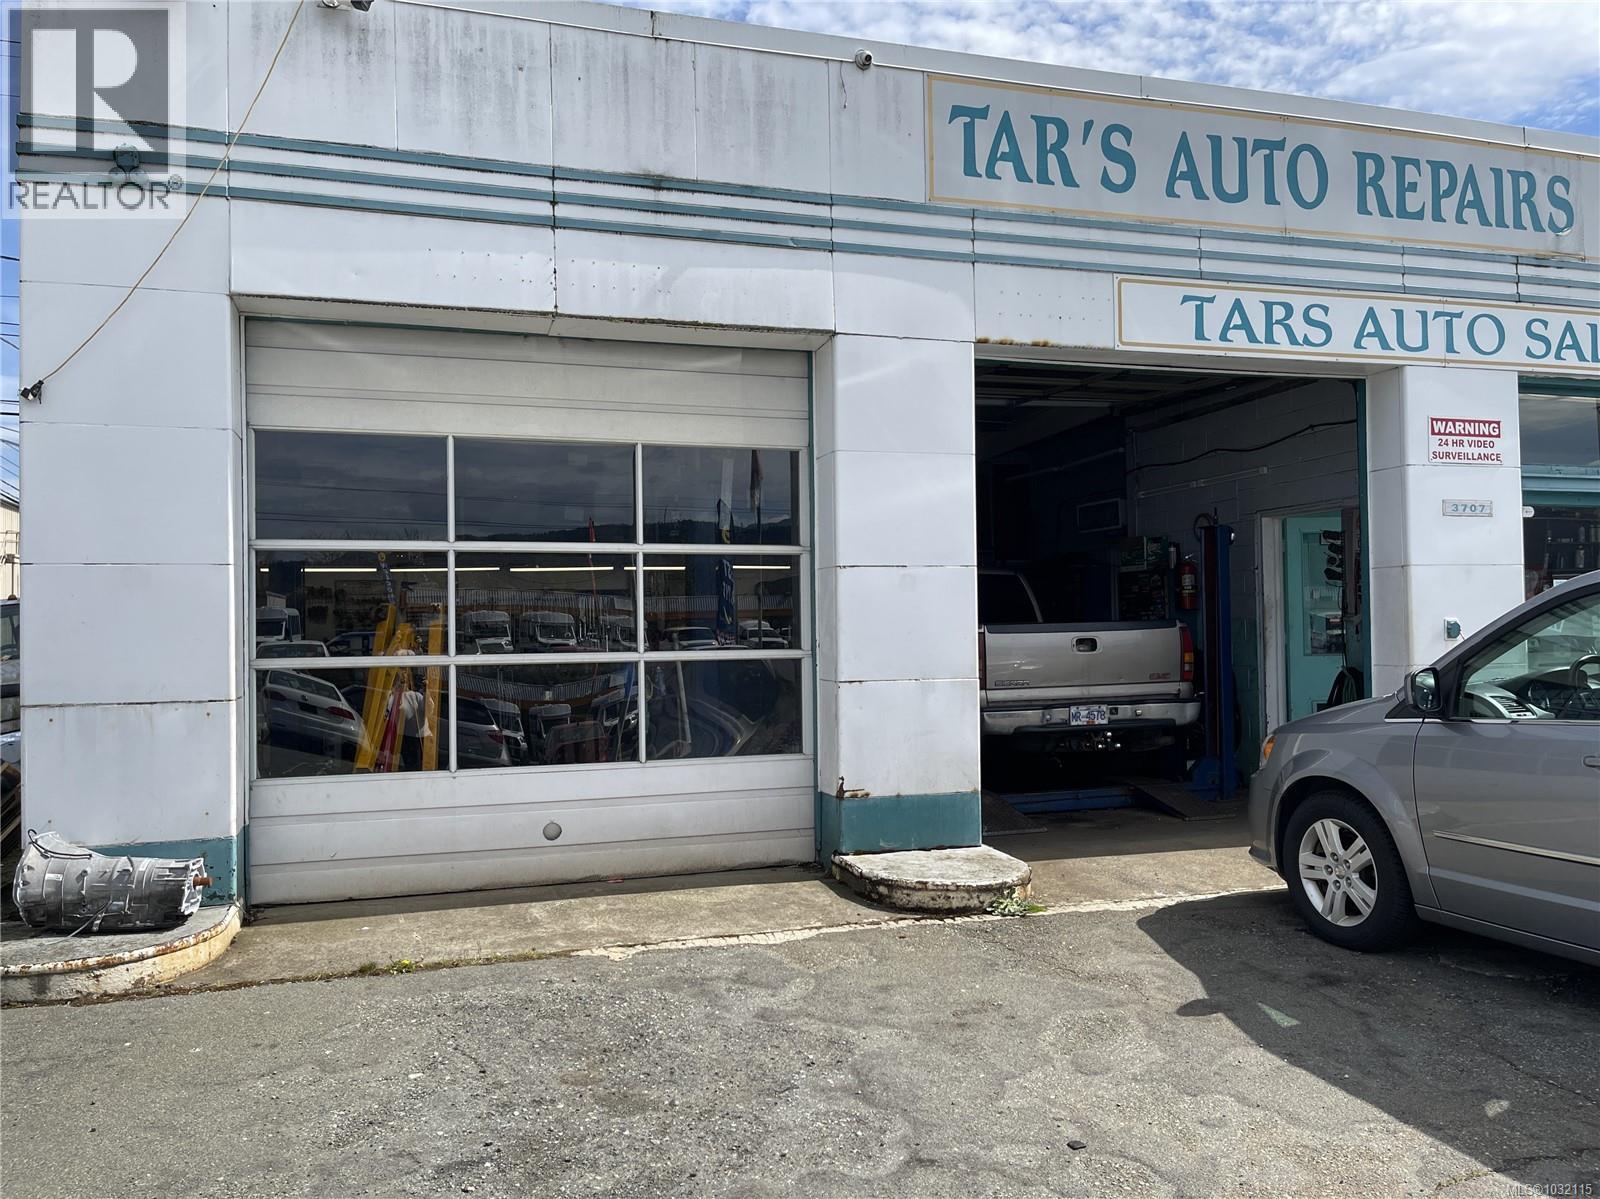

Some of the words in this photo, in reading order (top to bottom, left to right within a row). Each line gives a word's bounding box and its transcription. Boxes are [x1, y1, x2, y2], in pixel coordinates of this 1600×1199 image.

[948, 104, 1137, 194] TAR'S
[1165, 131, 1329, 210] AUTO
[1353, 151, 1574, 234] REPAIRS
[1181, 294, 1333, 348] TARS
[1353, 307, 1506, 356] AUTO
[1432, 420, 1500, 436] WARNING
[1437, 438, 1449, 448] 24
[1451, 438, 1465, 448] HR
[1467, 439, 1495, 449] VIDEO
[1432, 450, 1502, 462] SURVEILLANCE
[1451, 503, 1487, 513] 3707
